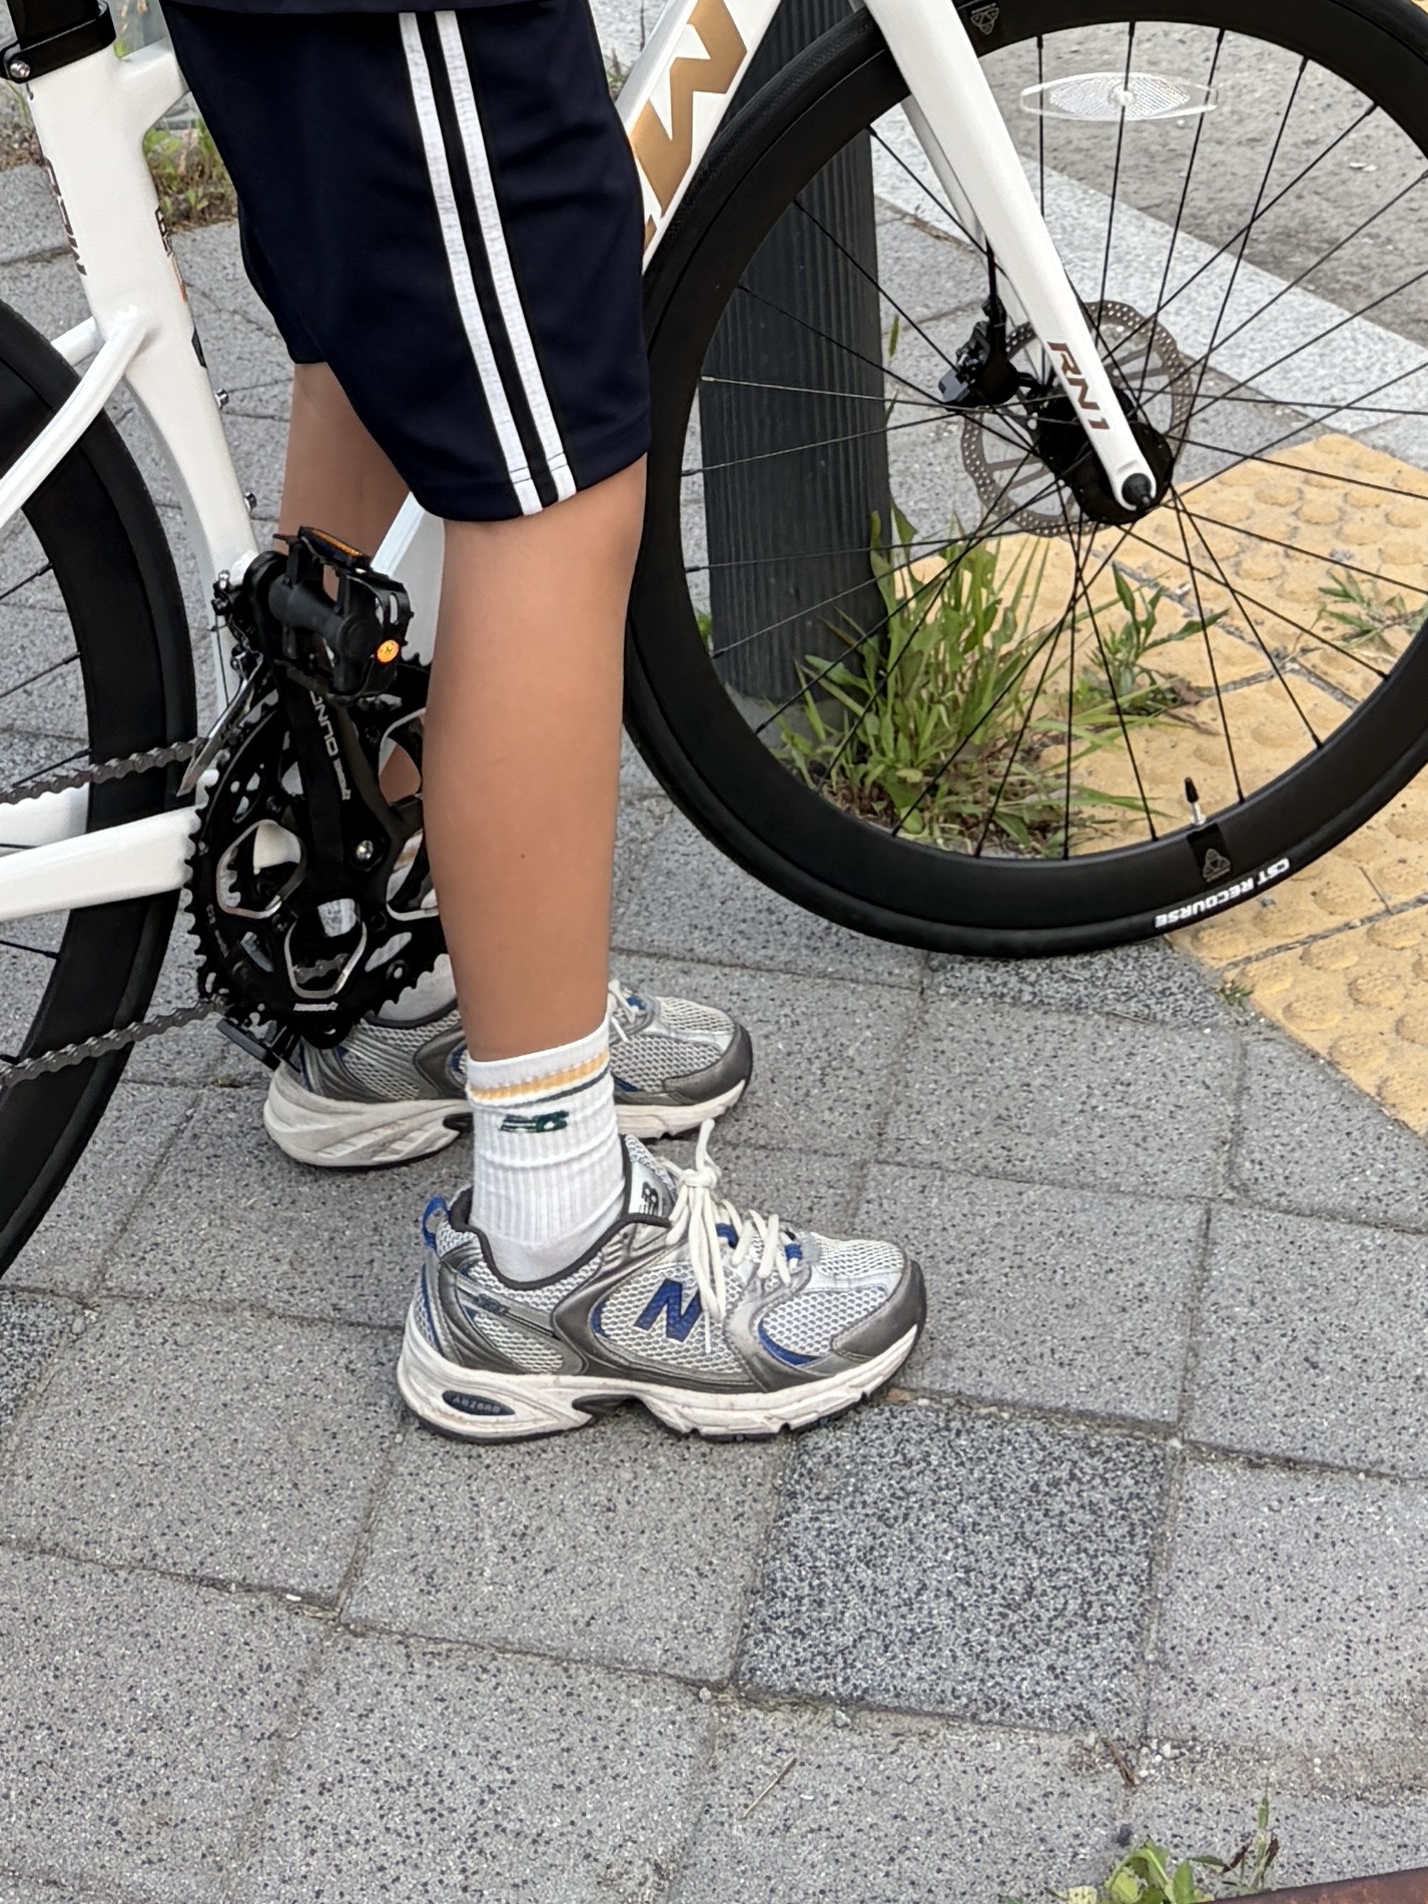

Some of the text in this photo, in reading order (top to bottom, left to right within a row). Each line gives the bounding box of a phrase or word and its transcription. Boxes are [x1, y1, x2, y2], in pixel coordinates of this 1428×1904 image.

[1047, 341, 1110, 430] RN1
[1155, 857, 1291, 929] CST RECOURSE
[633, 1278, 704, 1343] N
